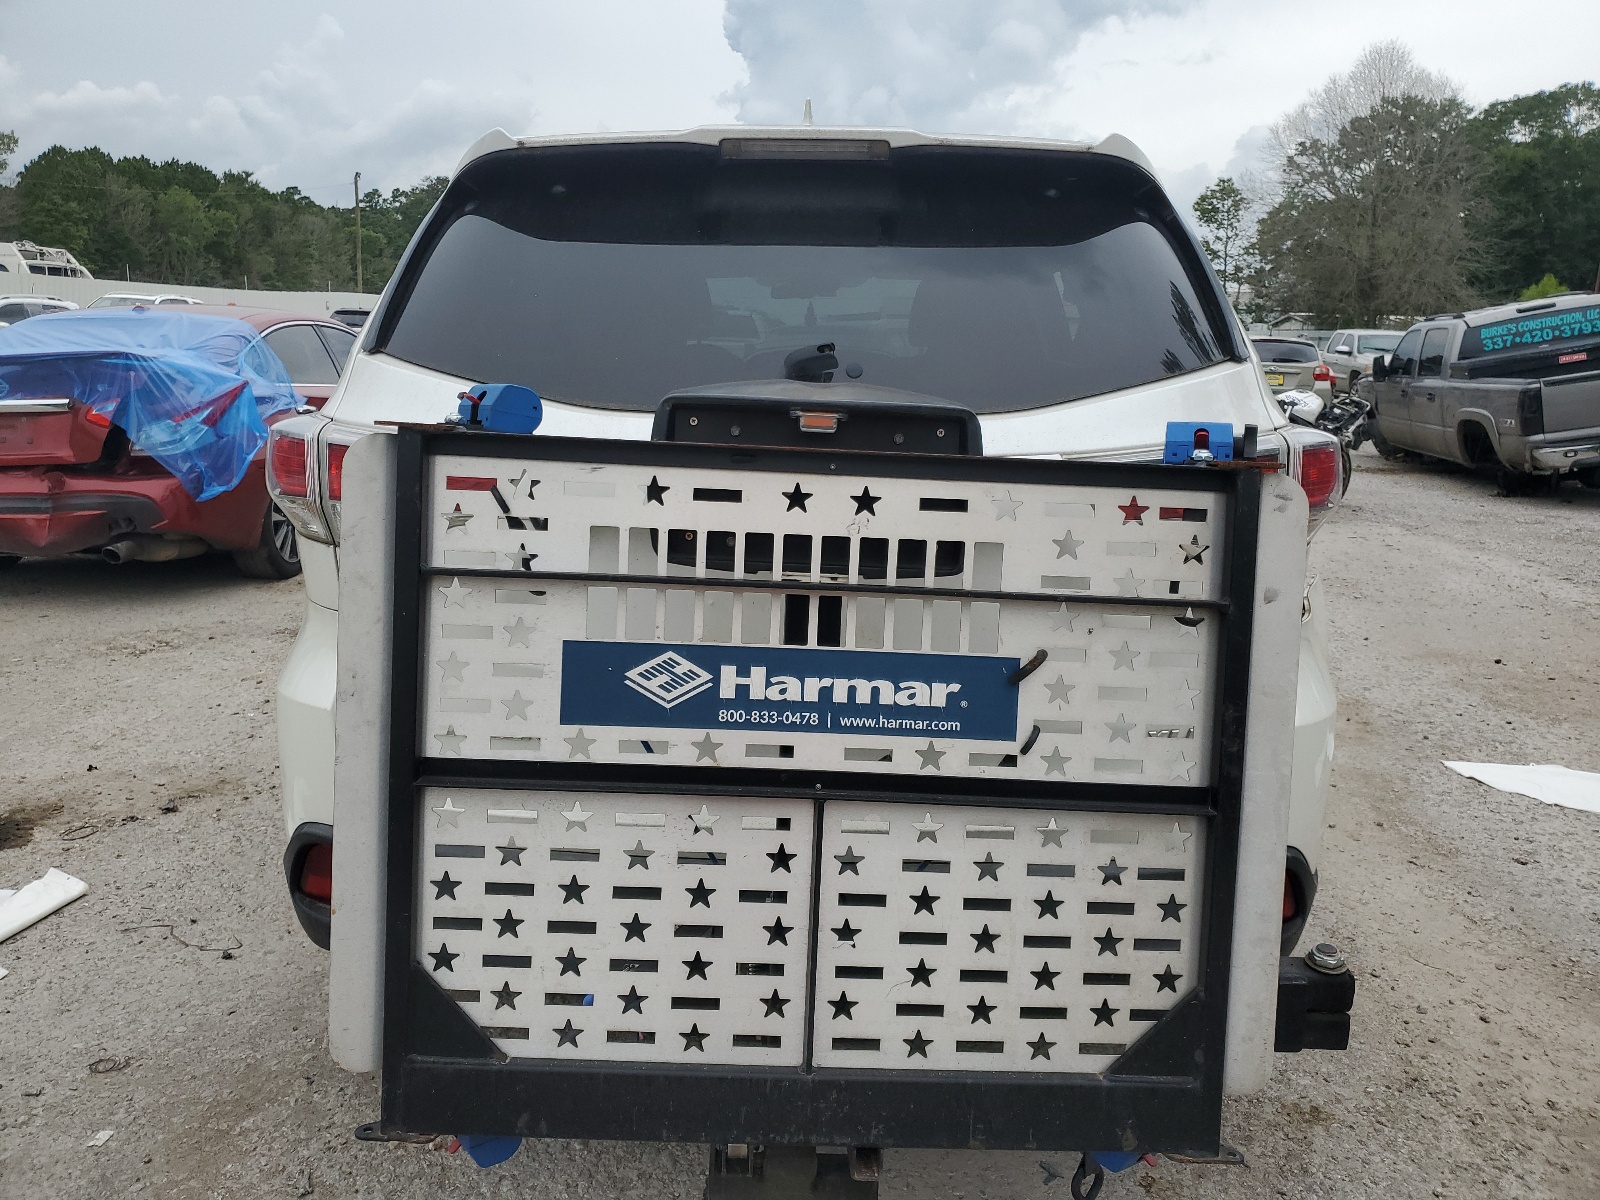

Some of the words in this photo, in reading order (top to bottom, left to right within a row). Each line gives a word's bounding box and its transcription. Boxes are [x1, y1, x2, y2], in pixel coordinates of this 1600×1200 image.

[1480, 323, 1517, 339] BURKE'S
[1518, 311, 1584, 332] CONSTRUCTION,
[1586, 308, 1600, 320] LLC
[719, 664, 962, 708] Harmar
[718, 709, 819, 726] 800-833-0478
[839, 713, 961, 732] www.harmar.com
